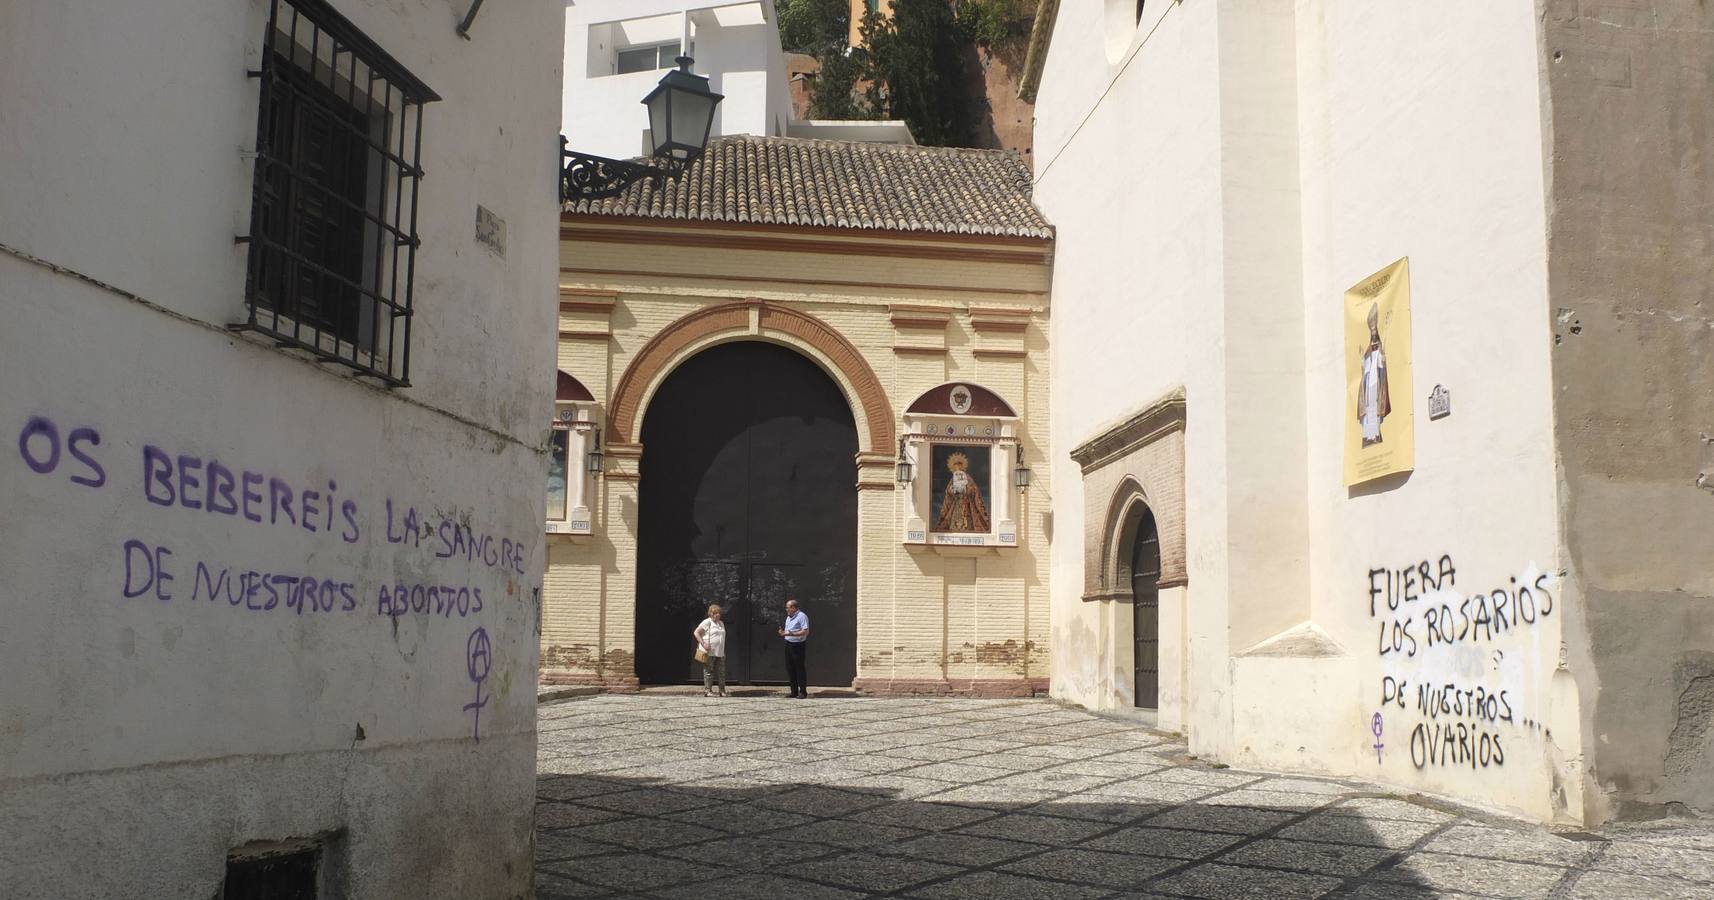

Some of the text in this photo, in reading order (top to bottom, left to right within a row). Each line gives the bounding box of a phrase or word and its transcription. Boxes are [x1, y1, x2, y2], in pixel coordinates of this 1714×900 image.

[19, 416, 106, 488] OS
[386, 497, 420, 548] LA
[435, 519, 525, 575] SANGRE
[123, 539, 483, 619] DE NUESTROS ABORTOS
[1368, 554, 1456, 617] FUERA
[1379, 617, 1417, 657] LOS
[1382, 675, 1407, 709] DE
[1418, 682, 1514, 724] NUESTROS
